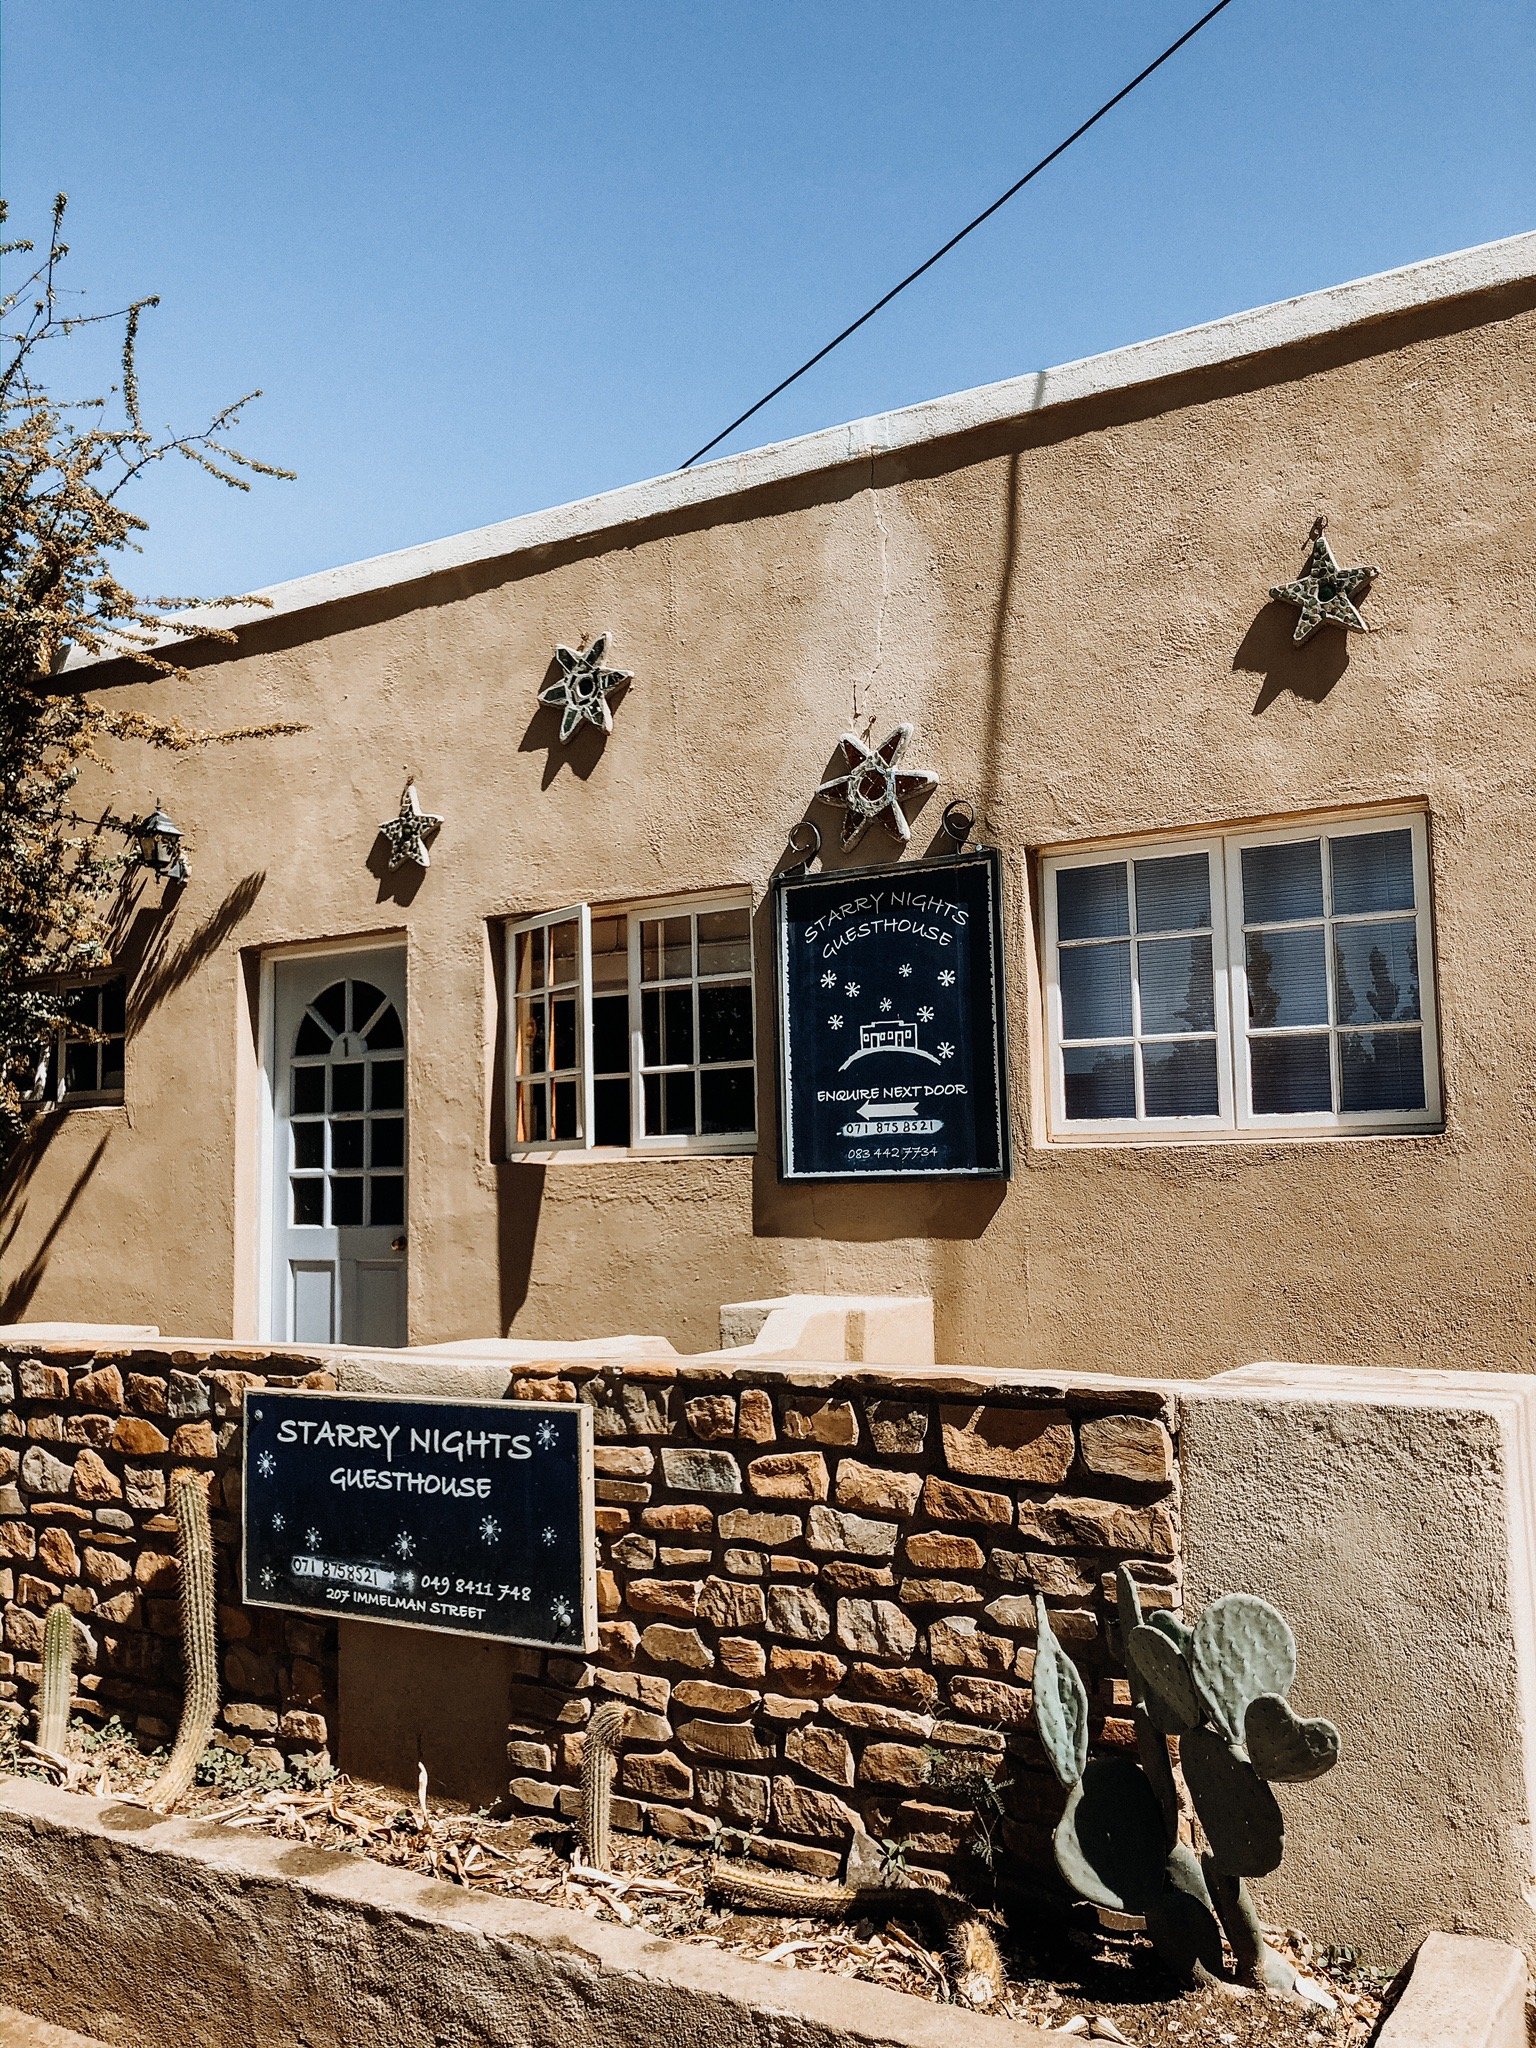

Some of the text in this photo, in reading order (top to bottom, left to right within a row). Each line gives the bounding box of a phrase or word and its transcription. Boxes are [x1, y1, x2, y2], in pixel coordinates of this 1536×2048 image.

[804, 891, 969, 944] STARRY NIGHTS
[822, 918, 953, 959] GUESTHOUSE
[342, 1036, 349, 1058] 1
[817, 1084, 968, 1102] ENQUIRE NEXT DOOR
[846, 1120, 934, 1134] 071 875 8521
[847, 1146, 938, 1160] 083 442 7734
[277, 1419, 533, 1462] STARRY NIGHTS
[330, 1467, 492, 1499] GUESTHOUSE
[292, 1557, 315, 1573] 071
[421, 1575, 450, 1596] 049
[455, 1580, 494, 1596] 8411
[497, 1584, 531, 1601] 748
[326, 1588, 486, 1620] 207 IMMELMAN STREET
